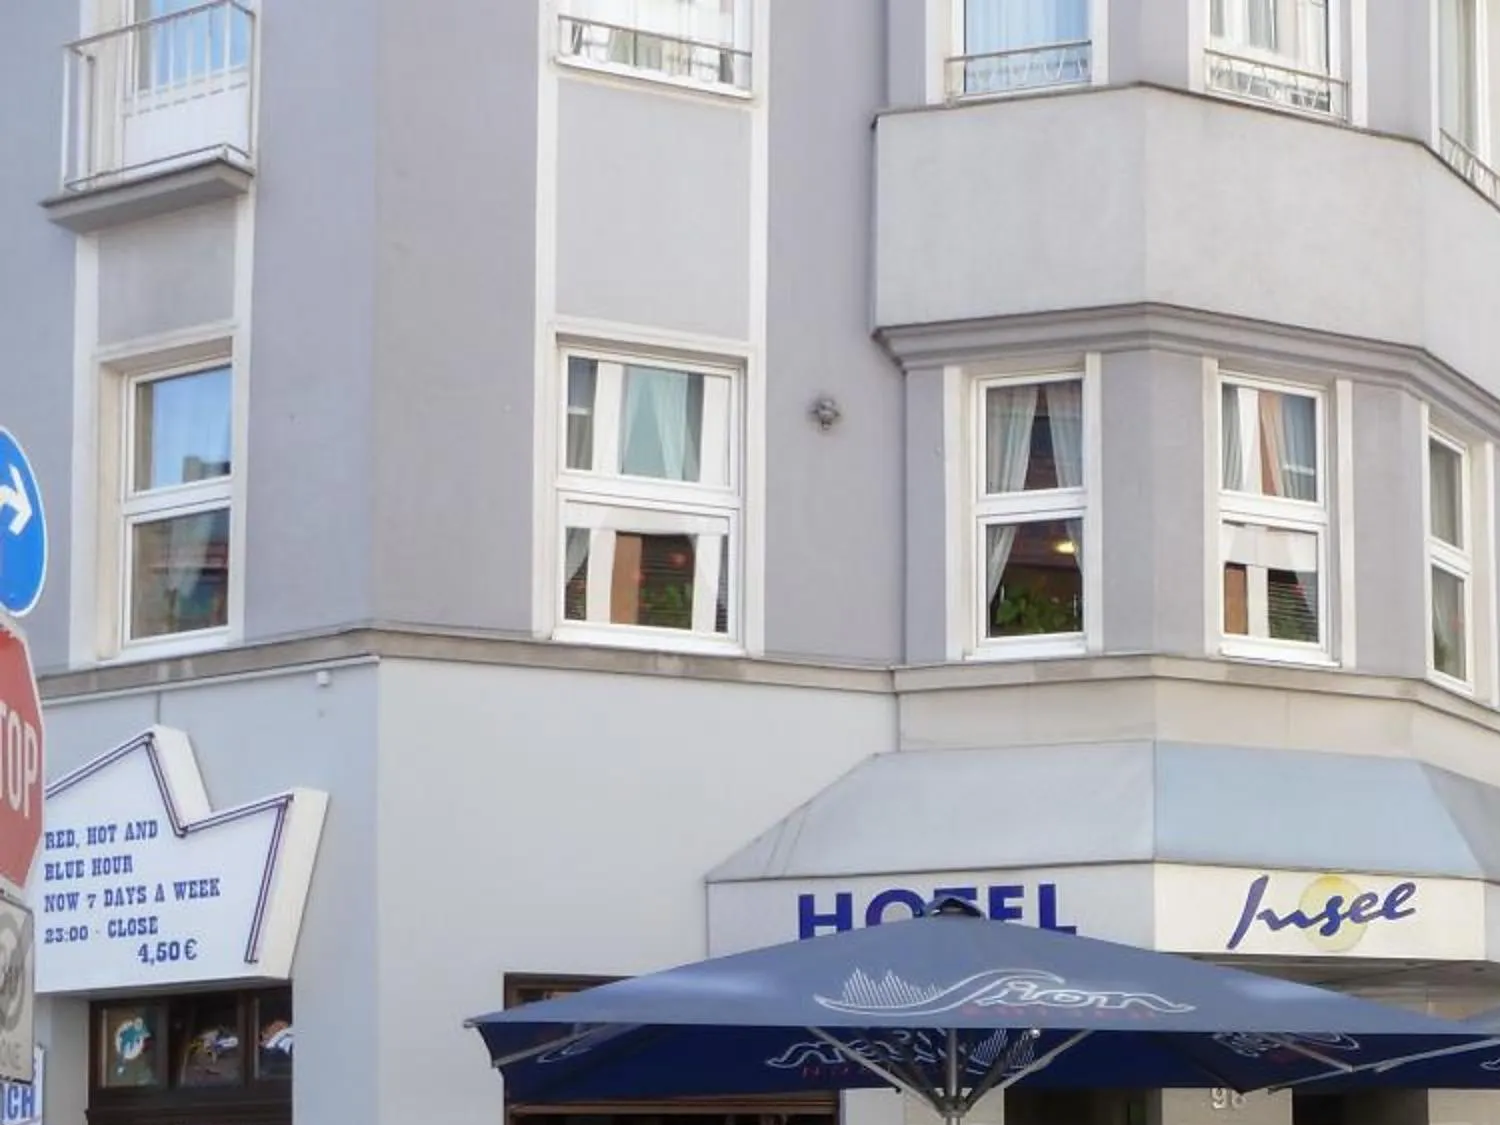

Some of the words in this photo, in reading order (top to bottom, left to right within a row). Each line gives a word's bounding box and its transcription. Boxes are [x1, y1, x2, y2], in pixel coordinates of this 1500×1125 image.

[87, 824, 117, 846] HOT
[125, 820, 158, 841] AND
[44, 860, 84, 882] BLUE
[91, 855, 133, 879] HOUR
[44, 892, 80, 913] NOW
[87, 894, 97, 909] 7
[104, 886, 147, 907] DAYS
[155, 884, 165, 902] A
[173, 878, 221, 901] WEEK
[1226, 874, 1416, 951] Insel
[107, 916, 159, 938] CLOSE
